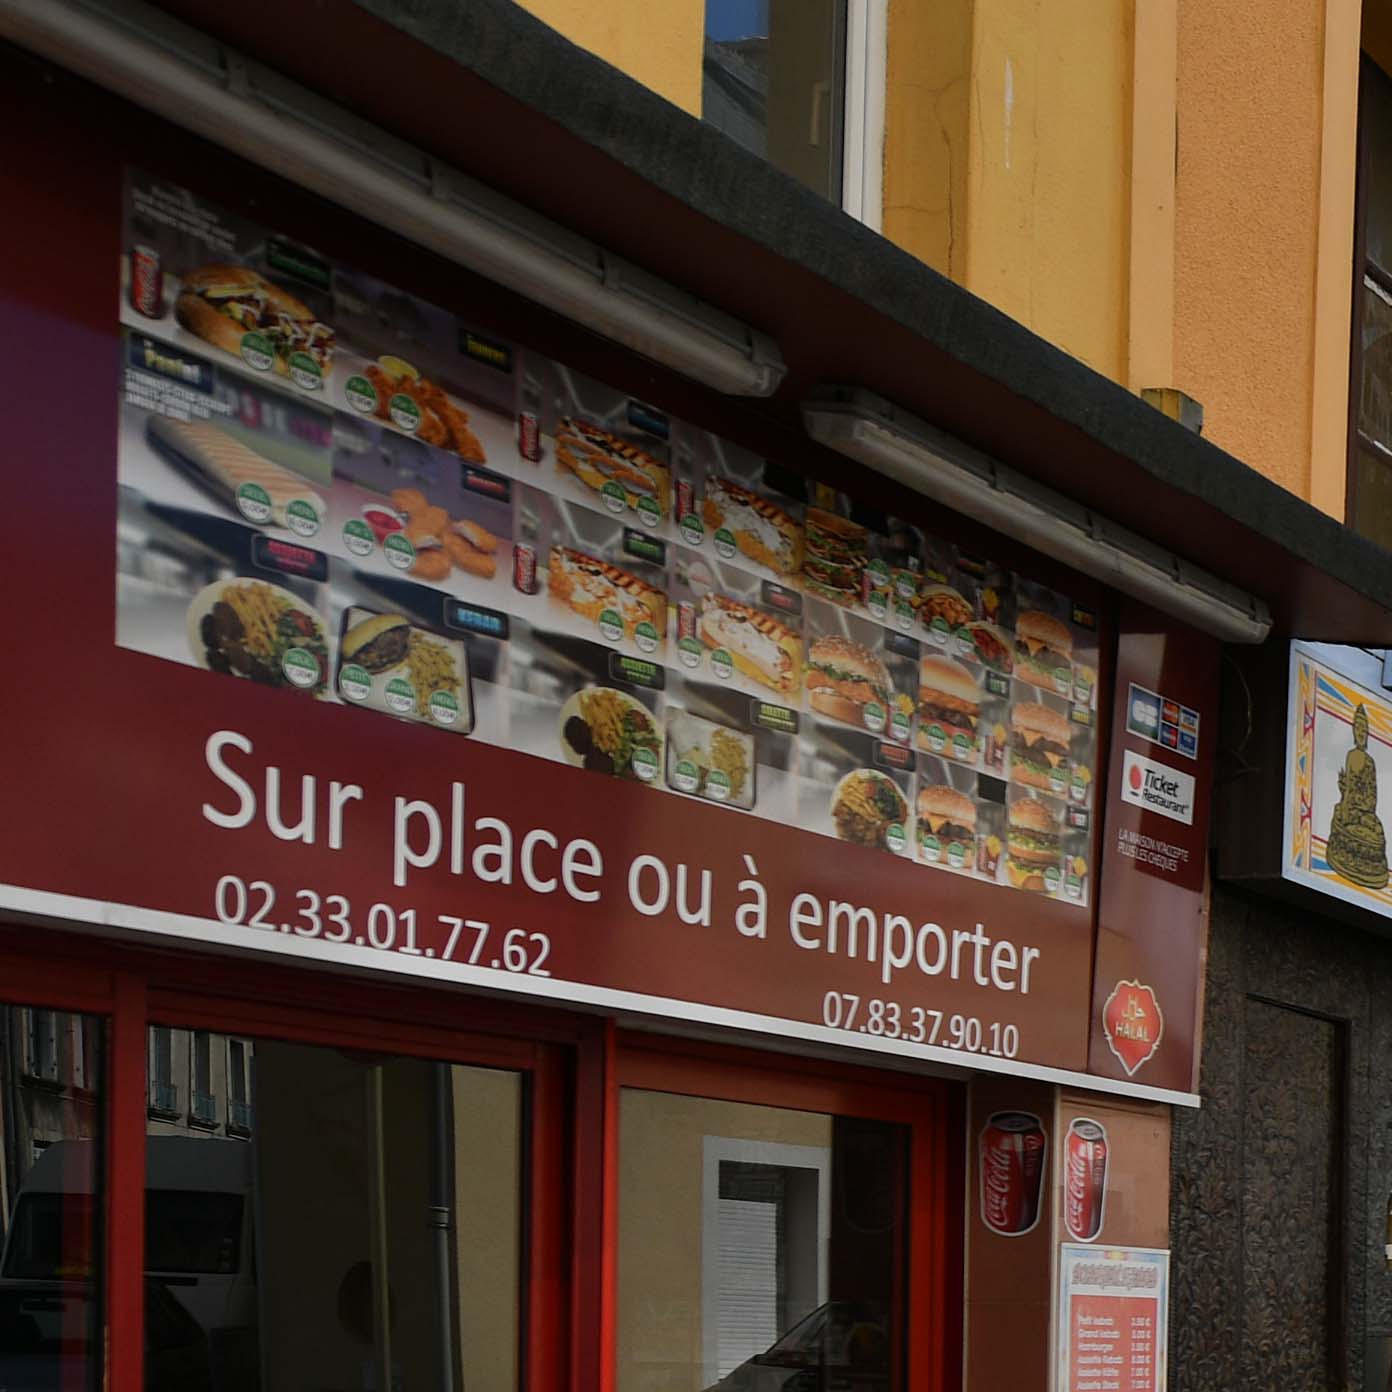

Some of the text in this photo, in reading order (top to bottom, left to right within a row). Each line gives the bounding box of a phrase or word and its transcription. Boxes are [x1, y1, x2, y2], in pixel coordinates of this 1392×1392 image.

[1143, 789, 1187, 815] Restaurant
[1144, 768, 1179, 798] Ticket
[202, 730, 1039, 994] Sur place ou à emporter
[214, 874, 551, 978] 02.33.01.77.62
[823, 990, 1020, 1058] 07.83.37.90.10
[1115, 1021, 1151, 1042] HALAL
